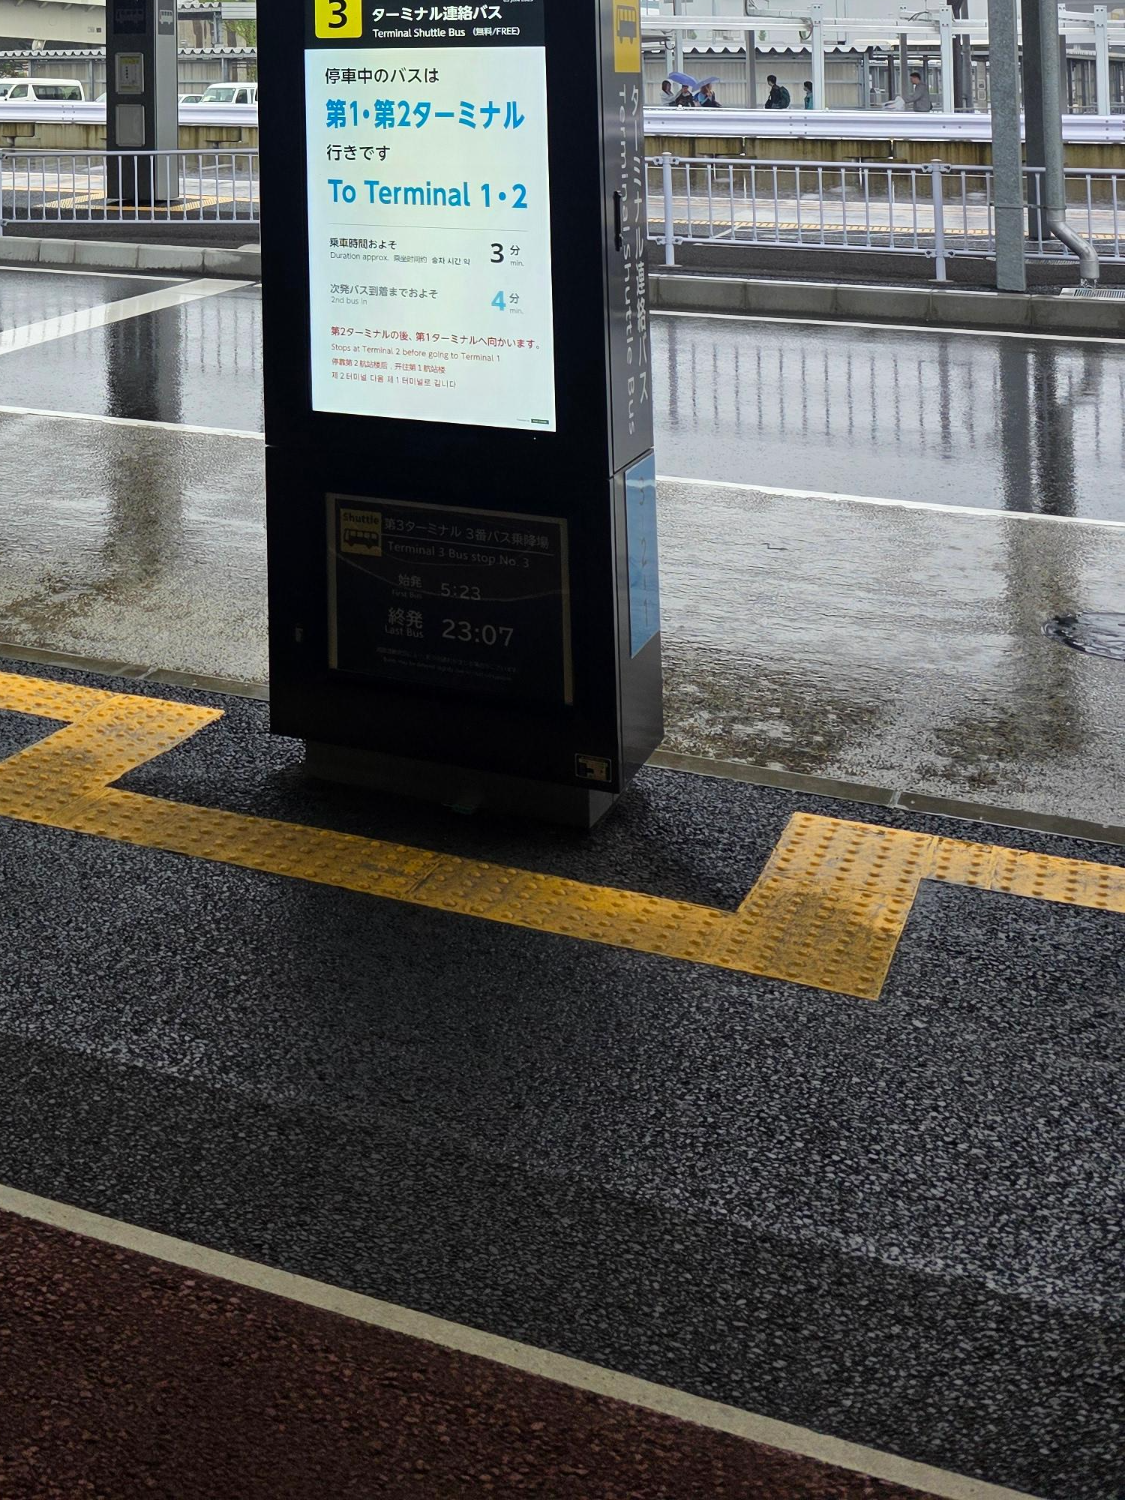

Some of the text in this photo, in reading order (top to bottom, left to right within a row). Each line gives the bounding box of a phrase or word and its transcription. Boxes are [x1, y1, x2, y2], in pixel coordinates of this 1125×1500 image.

[372, 5, 503, 22] ターミナル連絡バス
[373, 28, 412, 39] Terminal
[413, 27, 446, 38] Shuttle
[448, 28, 466, 37] Bus
[325, 67, 440, 84] 停車中のバスは
[325, 99, 526, 129] 第1・第2ターミナル
[326, 144, 391, 161] 行きです
[327, 178, 357, 204] To
[363, 179, 471, 207] Terminal
[329, 237, 397, 250] 乗車時間およそ
[510, 244, 521, 256] 分
[631, 85, 648, 404] ターミナル連絡バス
[330, 251, 361, 260] Duration
[362, 253, 389, 262] approx.
[447, 257, 462, 266] 시간
[490, 242, 505, 263] 3
[619, 84, 631, 232] Terminal
[627, 376, 635, 435] Bus
[510, 259, 524, 267] min.
[330, 283, 438, 300] 次発バス到着までおよそ
[509, 293, 520, 304] 分
[331, 295, 368, 306] 2nd bus in
[491, 290, 506, 311] 4
[509, 307, 524, 315] min.
[331, 343, 501, 362] Stops at Terminal 2 before going to Terminal 1
[342, 511, 379, 524] Shuttle
[384, 517, 462, 538] 第3ターミナル
[387, 540, 530, 568] Terminal 3 Bus stop No. 3
[397, 573, 423, 589] 始発
[440, 582, 481, 601] 5:23
[387, 607, 424, 629] 終発
[384, 623, 424, 638] Last Bus
[441, 618, 514, 647] 23:07
